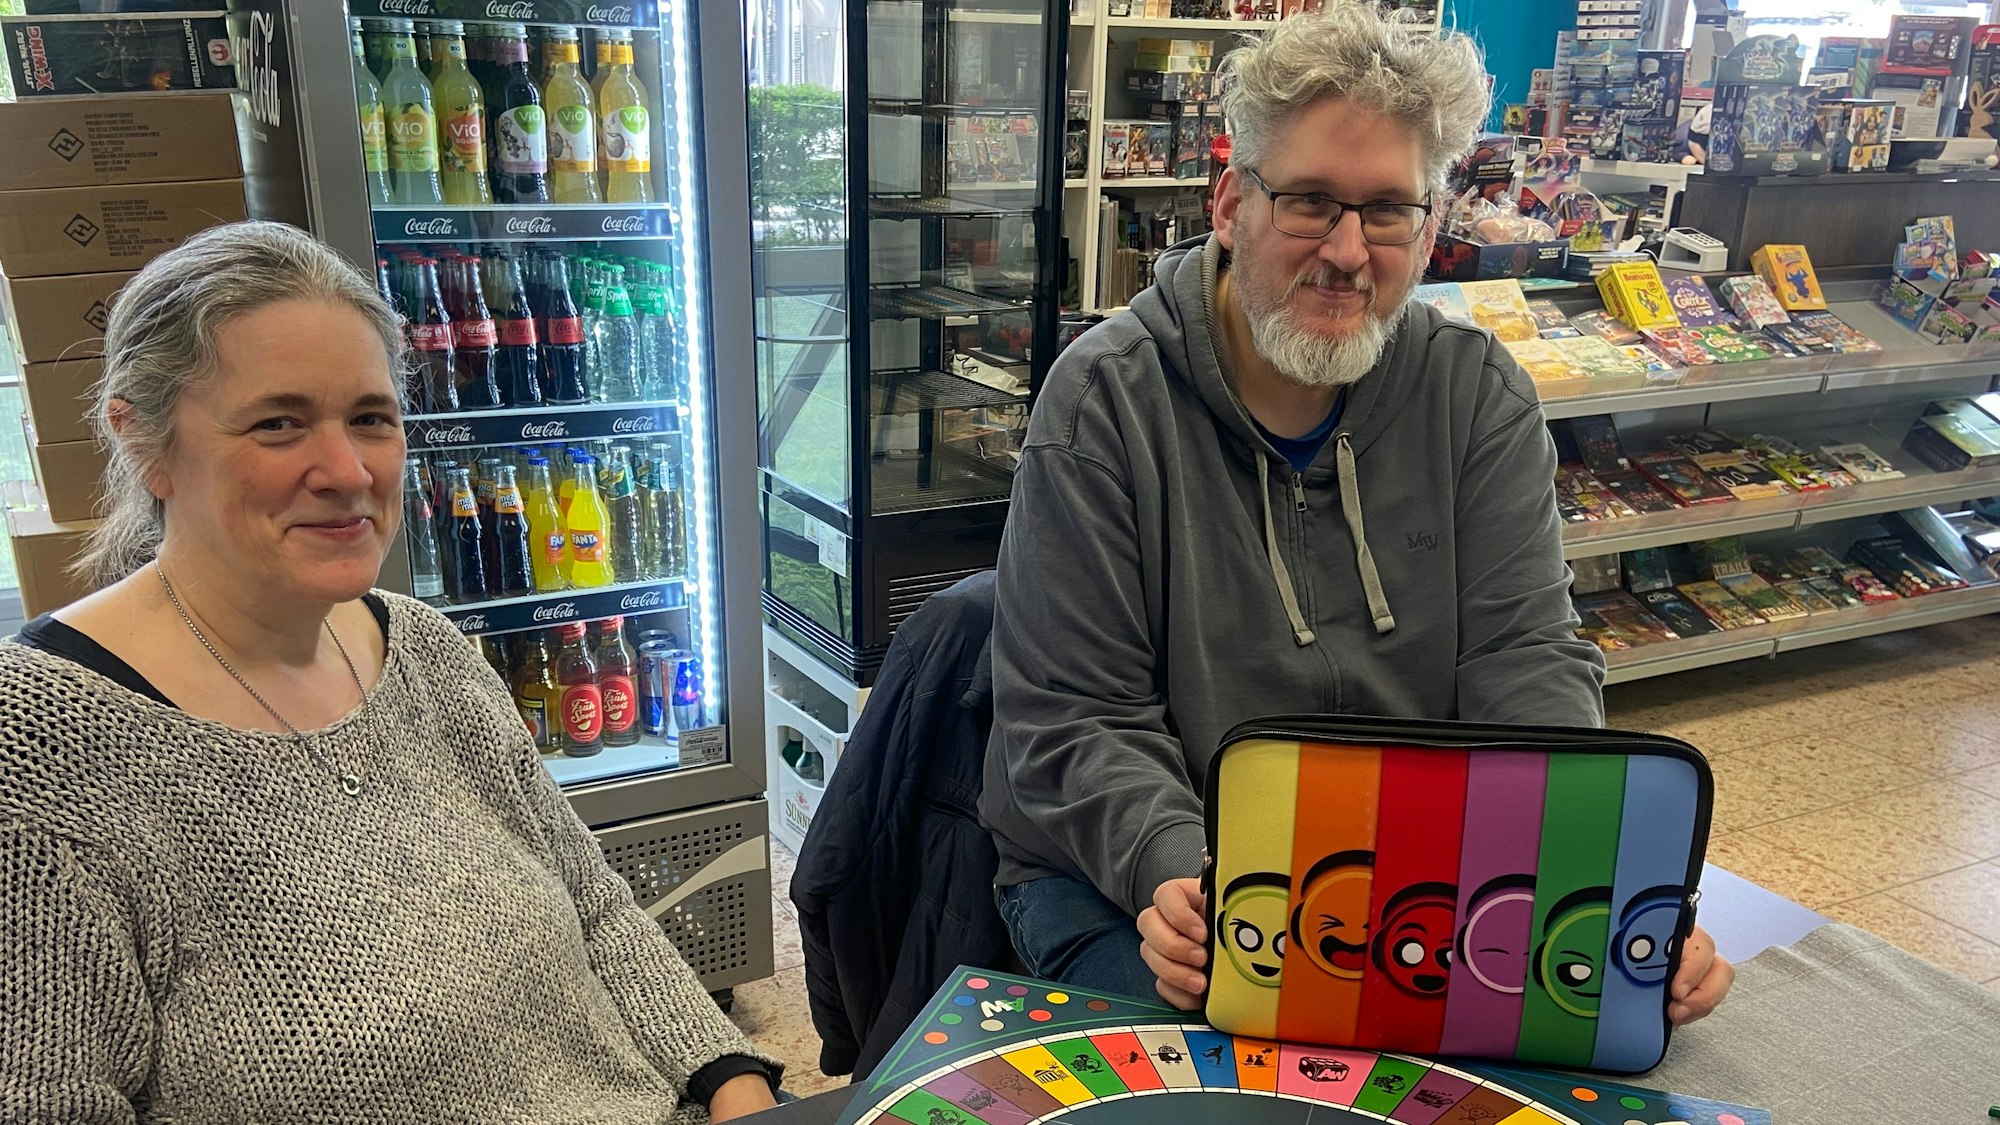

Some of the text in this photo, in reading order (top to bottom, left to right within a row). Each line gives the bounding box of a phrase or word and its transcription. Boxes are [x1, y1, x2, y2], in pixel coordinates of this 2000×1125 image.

[16, 29, 35, 89] STAR WARS
[26, 26, 55, 91] X-WING
[182, 18, 202, 88] REBELLENALLIANZ
[404, 217, 454, 235] Coca-Cola
[505, 215, 552, 235] Coca-Cola
[601, 215, 645, 233] Coca-Cola
[521, 421, 566, 438] Coca-Cola
[572, 533, 598, 544] FANTA
[1715, 560, 1751, 575] TRAILS
[533, 602, 576, 621] Coca-Cola
[1762, 603, 1800, 617] TRAILS
[604, 689, 629, 704] Früh
[571, 699, 596, 714] Früh
[603, 700, 628, 713] Sport
[571, 709, 596, 723] Sport
